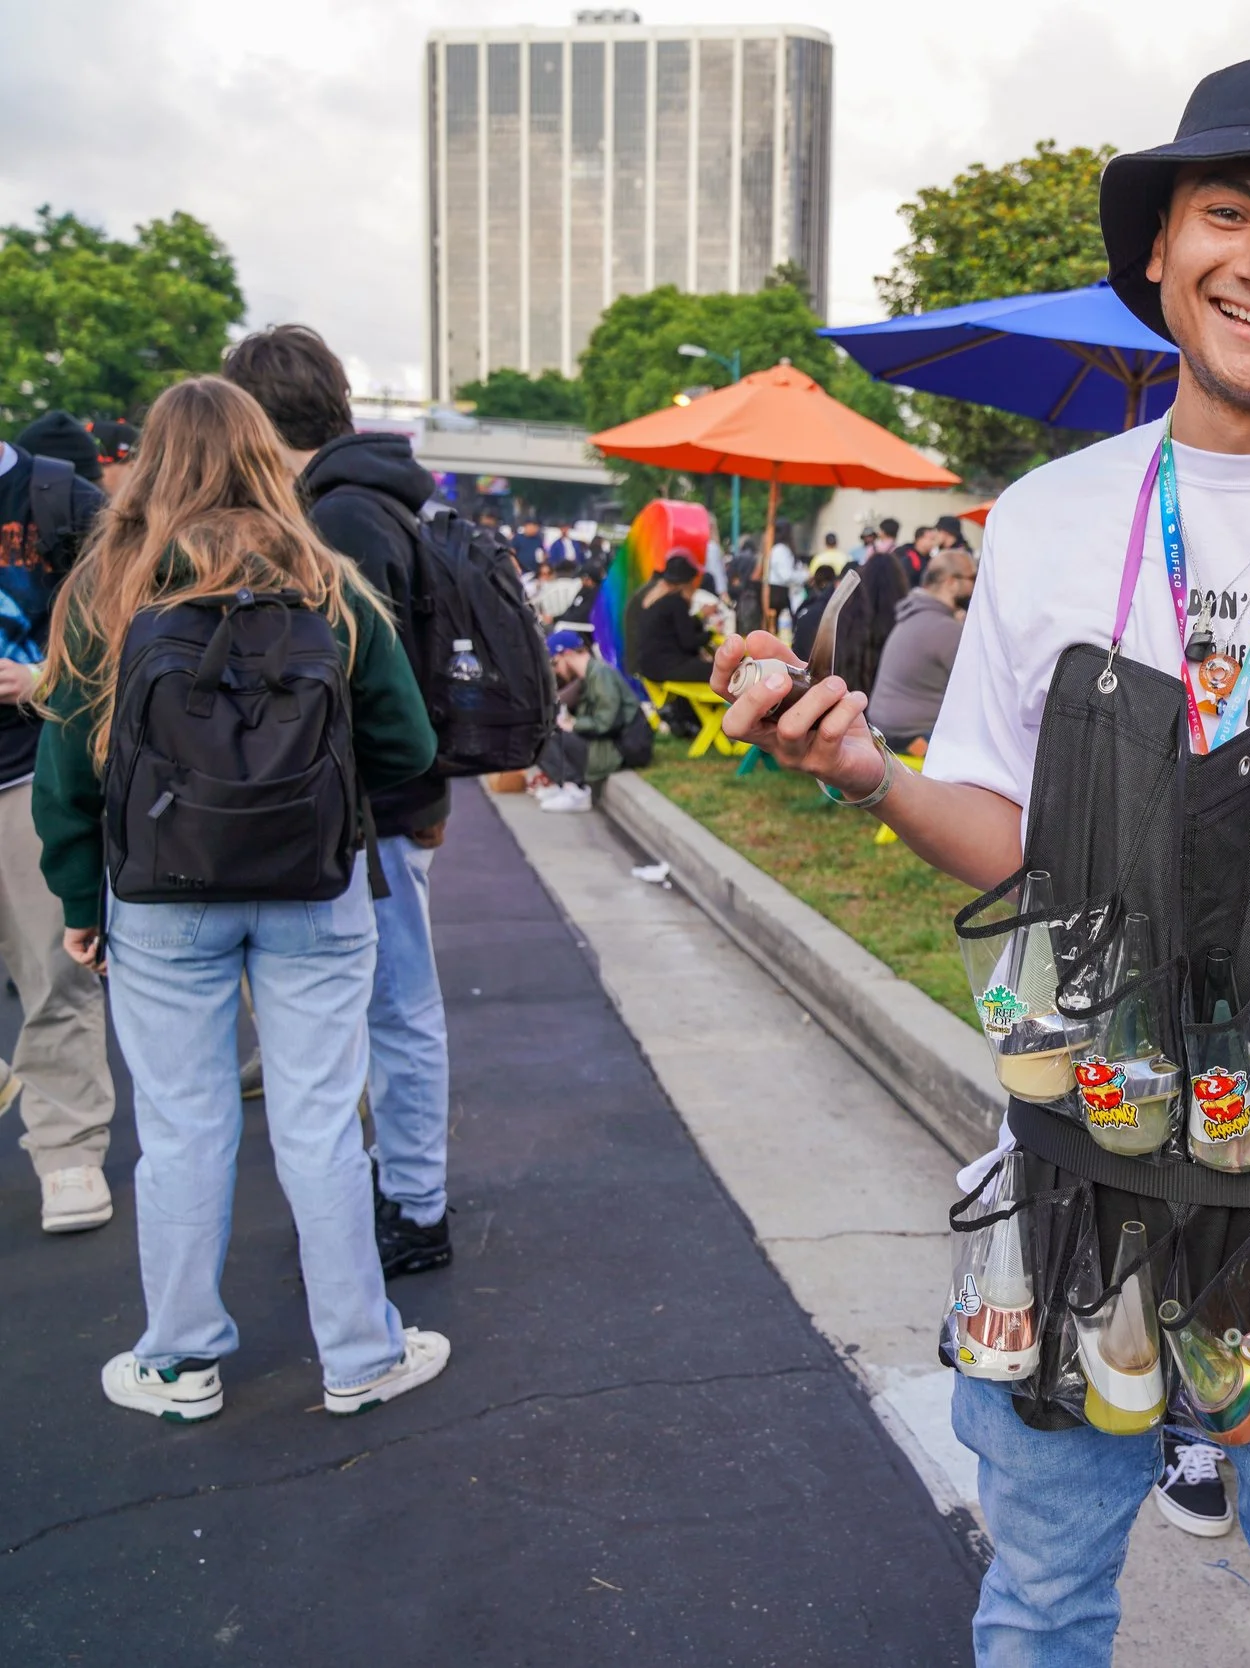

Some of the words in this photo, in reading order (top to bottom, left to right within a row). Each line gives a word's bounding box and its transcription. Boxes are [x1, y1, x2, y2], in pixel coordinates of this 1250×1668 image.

[1164, 472, 1174, 515] PUFFCO
[1169, 543, 1182, 588] PUFFCO
[1186, 694, 1202, 741] PUFFCO
